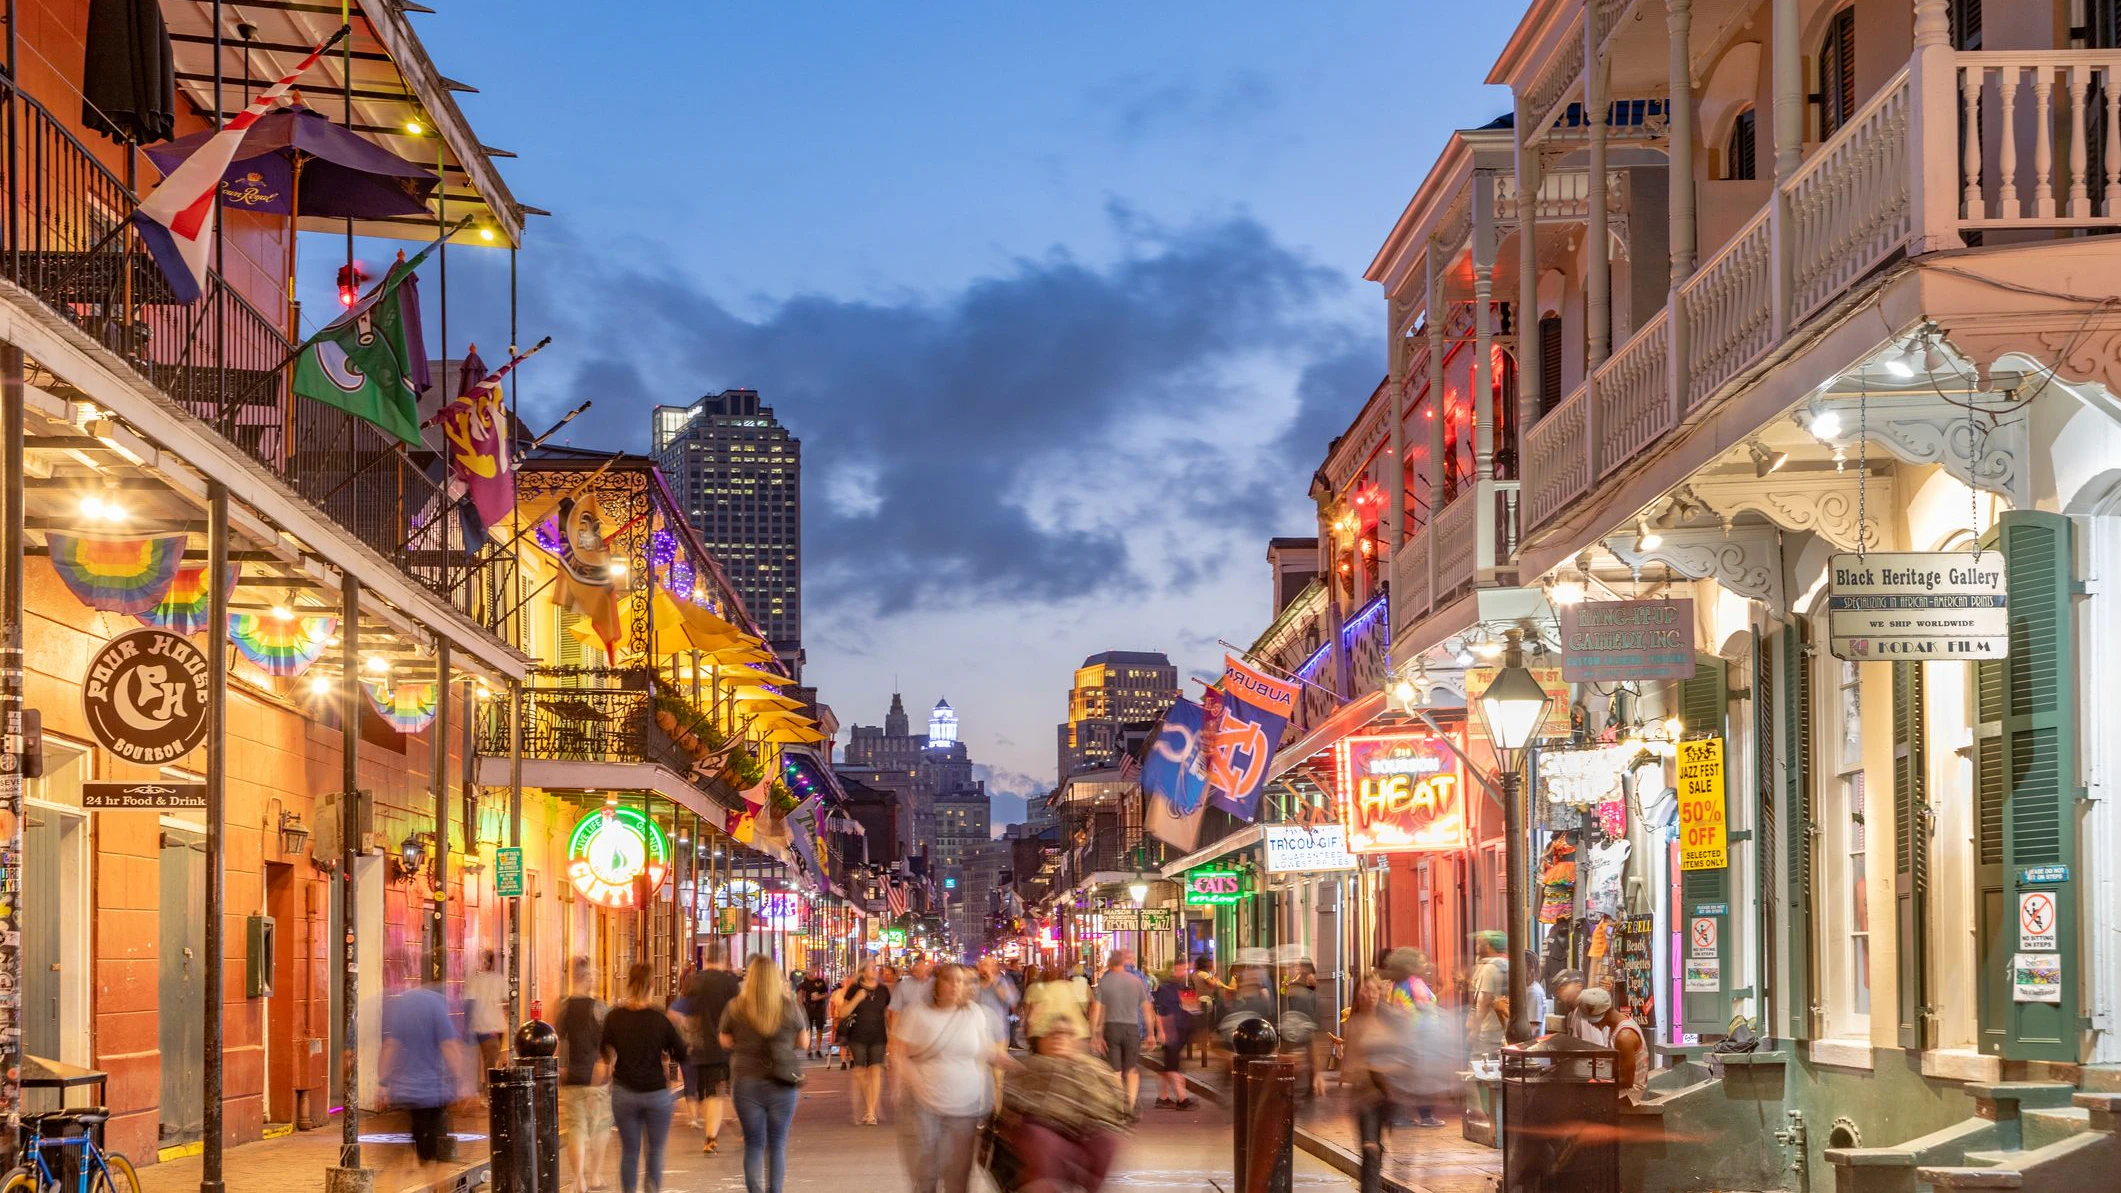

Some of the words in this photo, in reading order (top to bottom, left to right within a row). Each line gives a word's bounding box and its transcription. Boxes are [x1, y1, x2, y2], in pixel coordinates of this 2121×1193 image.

[233, 187, 279, 205] Royal
[1836, 569, 1875, 586] Black
[1882, 568, 1941, 590] Heritage
[1949, 568, 1999, 590] Gallery
[1844, 596, 1887, 609] SPECIALIZING
[1890, 596, 1897, 608] IN
[1971, 595, 1994, 608] PRINTS
[1889, 620, 1912, 628] SHIP
[1916, 620, 1975, 628] WORLDWIDE
[1649, 629, 1685, 649] INC.
[1878, 641, 1939, 653] KODAK
[1948, 641, 1991, 652] FILM
[87, 639, 140, 702] POUR
[1477, 672, 1492, 683] 715
[1546, 672, 1559, 682] ST
[113, 738, 185, 761] BOURBON
[1680, 766, 1698, 779] JAZZ
[1700, 763, 1719, 777] FEST
[1688, 780, 1712, 794] SALE
[86, 796, 102, 806] 24
[105, 796, 120, 806] hr
[122, 796, 152, 806] Food
[155, 796, 166, 806] &
[1359, 773, 1458, 828] HEAT
[1682, 800, 1722, 823] 50%
[576, 832, 589, 851] LIVE
[585, 818, 601, 833] LIFE
[1688, 827, 1716, 846] OFF
[1270, 837, 1314, 851] TRICOU
[1318, 836, 1343, 849] GIF
[1686, 850, 1721, 859] SELECTED
[1683, 860, 1704, 869] ITEMS
[1706, 859, 1724, 867] ONLY
[1104, 908, 1132, 916] MAISON
[1102, 914, 1150, 930] PRESERVATON
